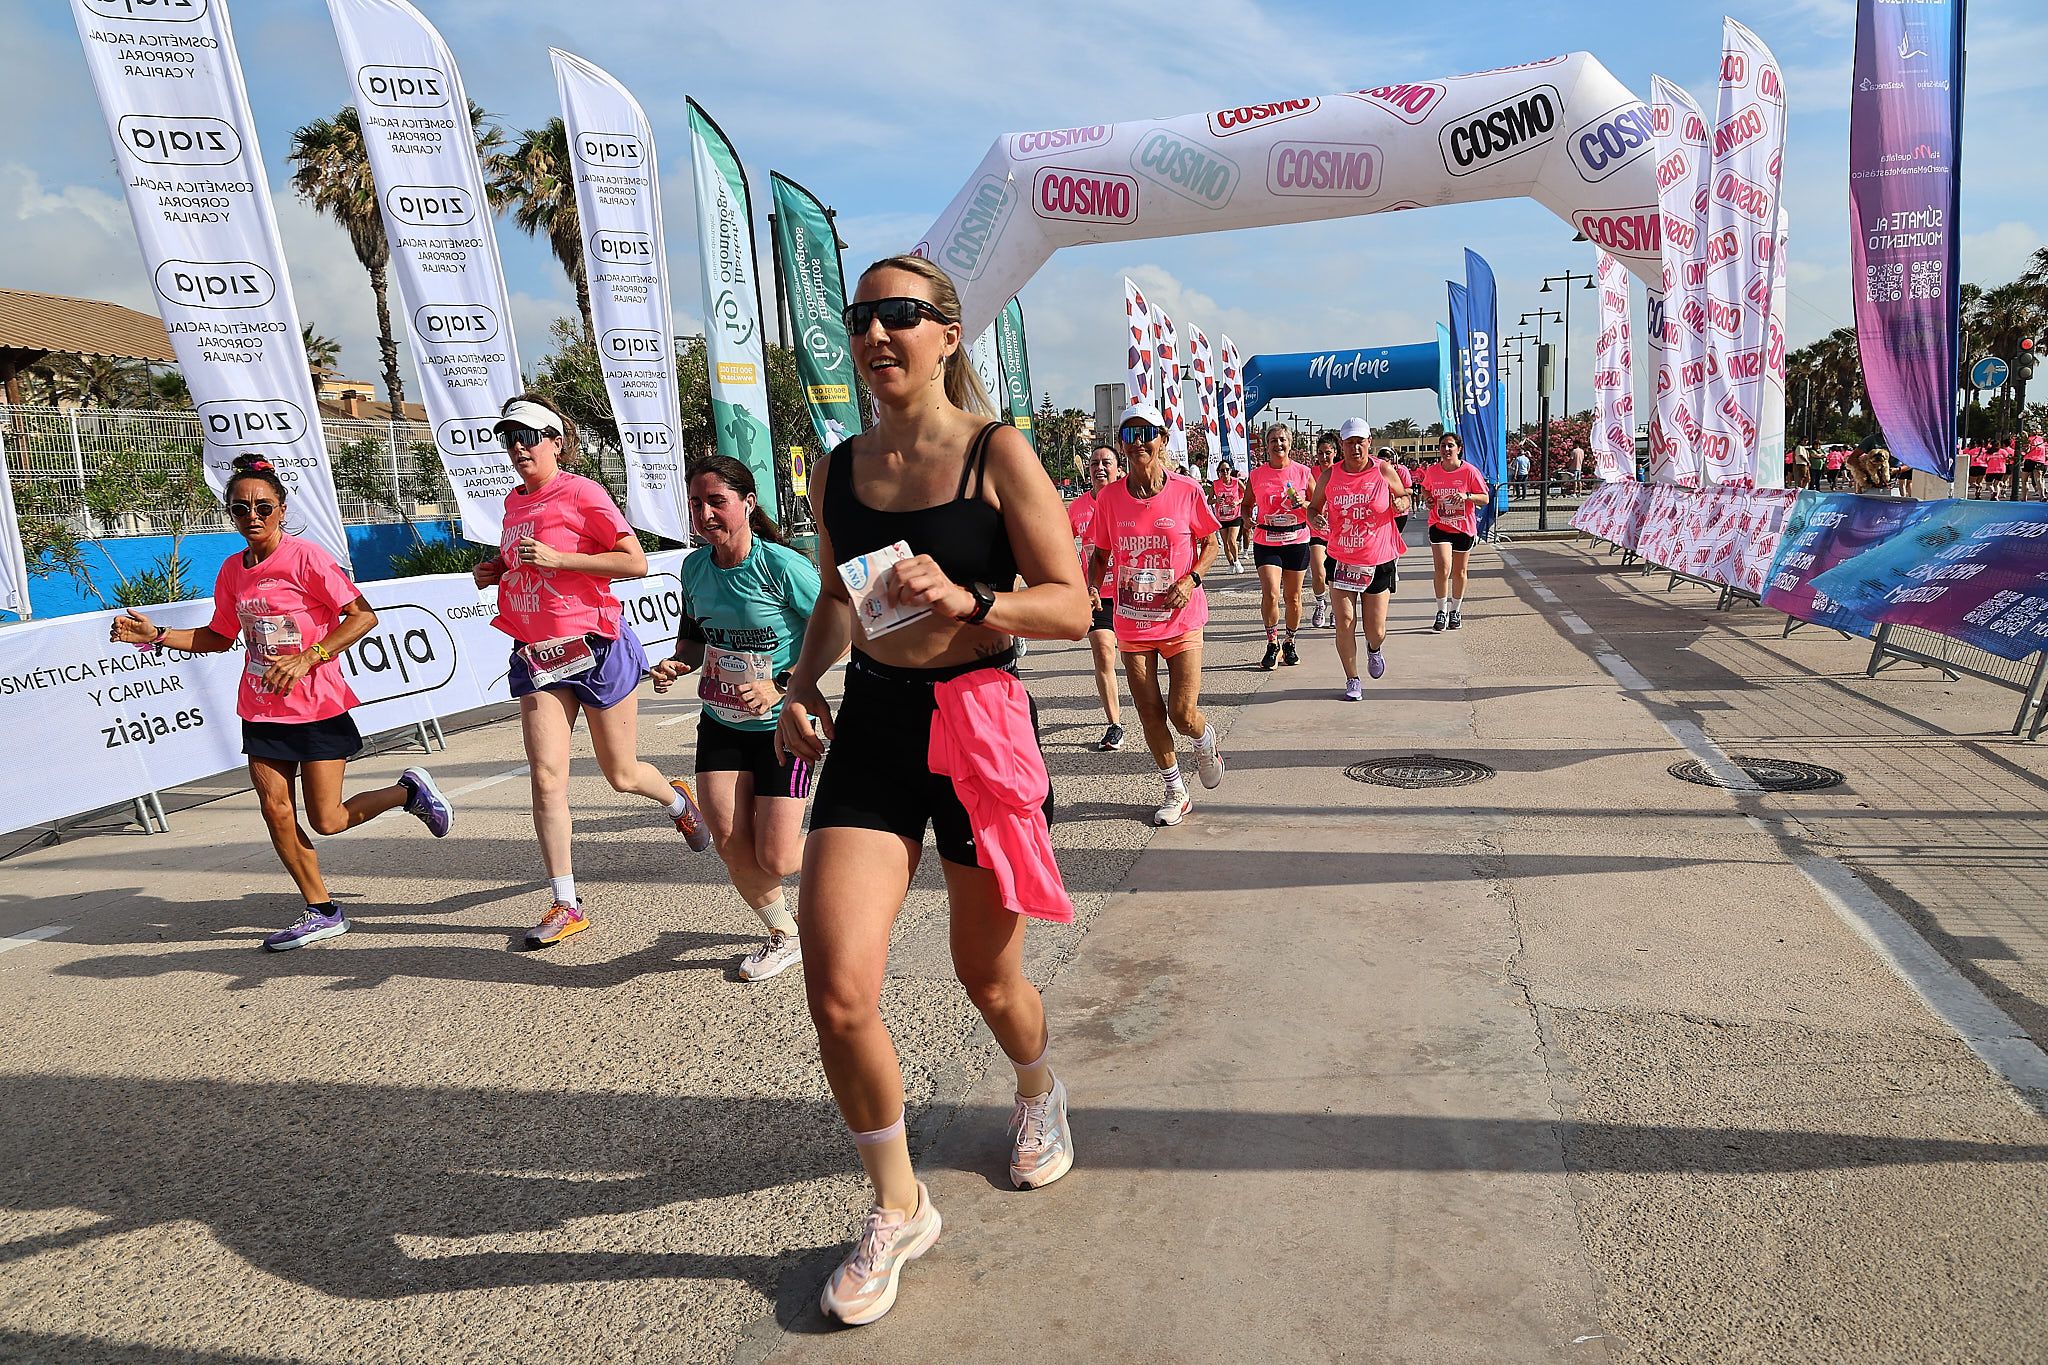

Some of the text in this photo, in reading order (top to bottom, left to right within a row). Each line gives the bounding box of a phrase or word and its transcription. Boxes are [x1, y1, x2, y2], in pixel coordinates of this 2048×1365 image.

[1018, 125, 1106, 153] COSMO
[1450, 93, 1556, 167] COSMO
[1579, 105, 1654, 171] COSM
[1140, 133, 1231, 202] COSMO
[1276, 148, 1374, 191] COSMO
[1041, 173, 1131, 218] COSMO
[945, 182, 1010, 271] COSMO
[1582, 213, 1662, 251] COSM
[1309, 352, 1389, 389] Marlene
[1333, 493, 1371, 505] CARRERA
[1352, 507, 1365, 520] DE
[1119, 535, 1168, 551] CARRERA
[1337, 537, 1365, 548] MUJER
[446, 602, 499, 620] COSMÉTIC
[628, 591, 681, 631] iaja
[1133, 592, 1154, 602] 016
[345, 627, 436, 683] iaja
[539, 645, 566, 662] 016
[88, 675, 184, 707] Y CAPILAR
[720, 682, 736, 695] 01
[101, 705, 204, 749] ziaja.es
